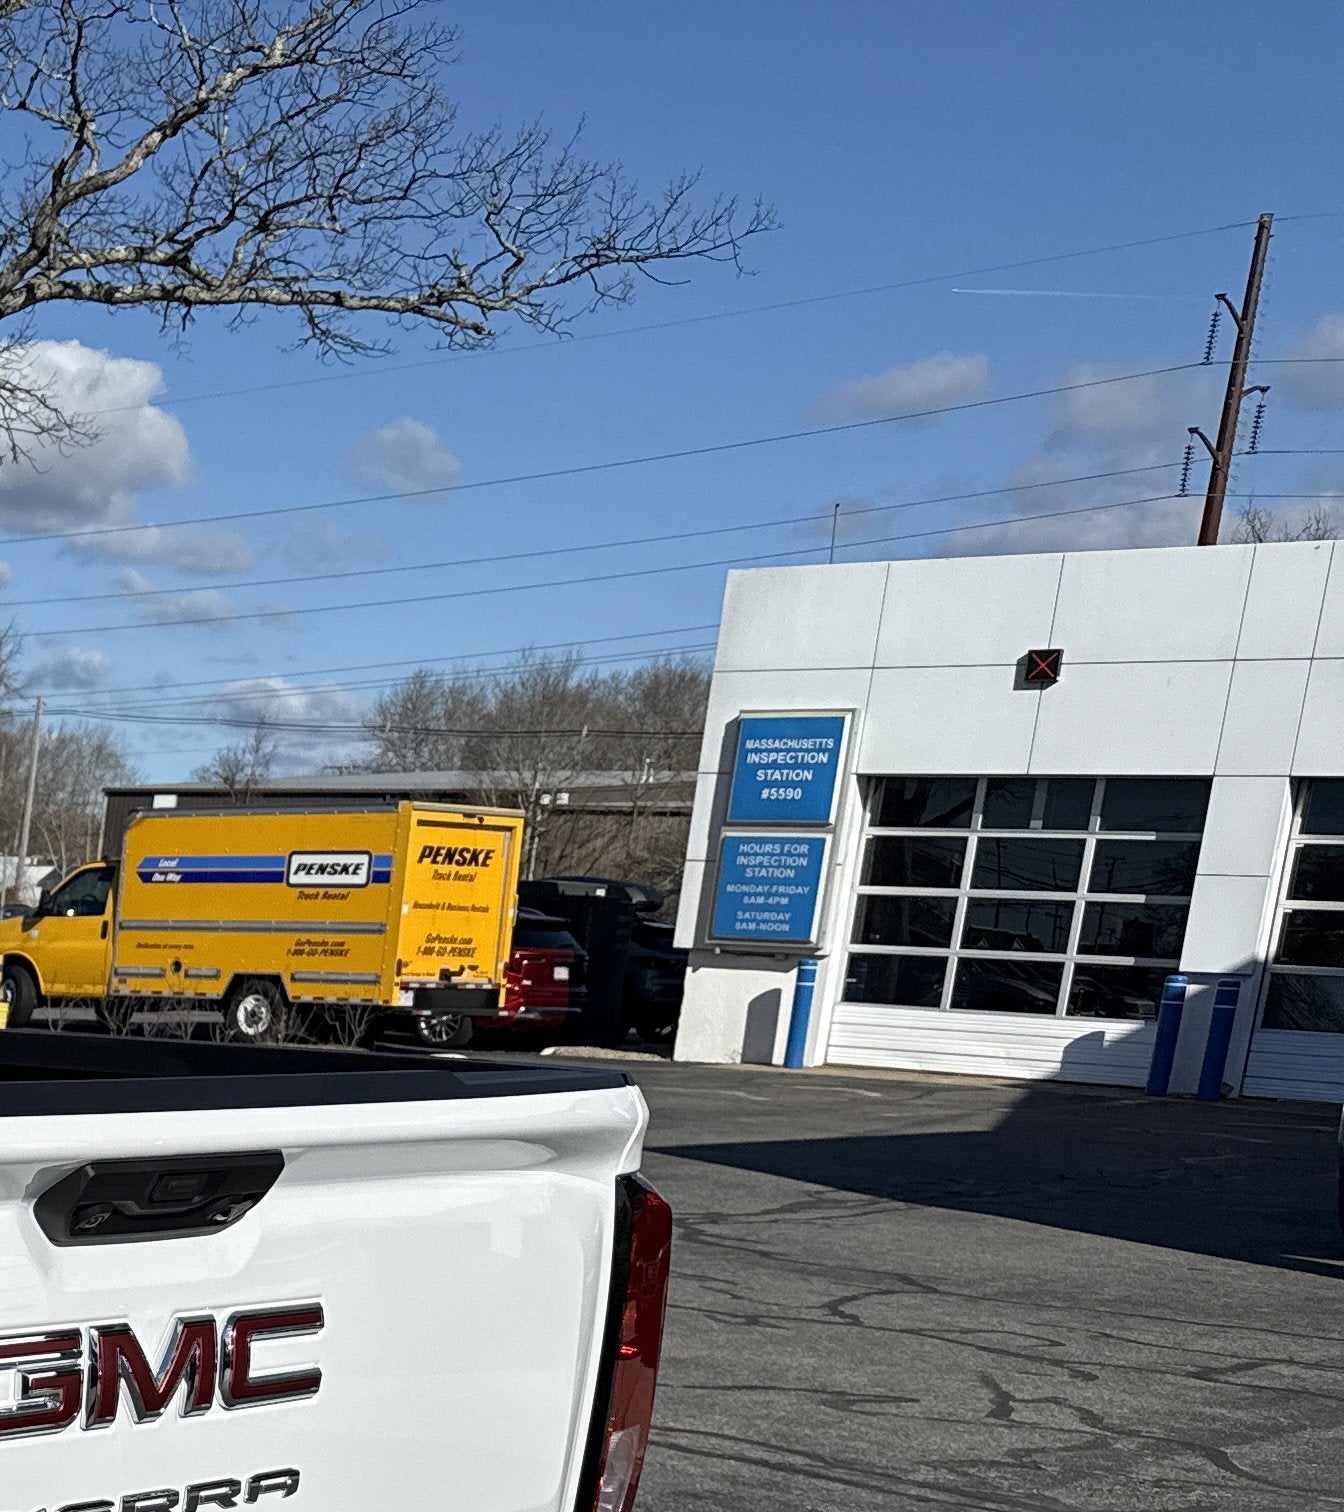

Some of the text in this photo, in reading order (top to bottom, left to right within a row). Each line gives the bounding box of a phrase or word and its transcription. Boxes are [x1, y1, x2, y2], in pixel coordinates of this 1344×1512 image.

[745, 738, 834, 749] MASSACHUSETTS
[746, 752, 829, 764] INSPECTION
[756, 769, 813, 781] STATION
[760, 787, 802, 800] #5590
[738, 843, 809, 854] HOURS FOR
[417, 845, 496, 867] PENSKE
[736, 855, 808, 866] INSPECTION
[293, 863, 364, 876] PENSKE
[745, 867, 795, 878] STATION
[726, 884, 810, 895] MONDAY-FRIDAY
[736, 911, 791, 920] SATURDAY
